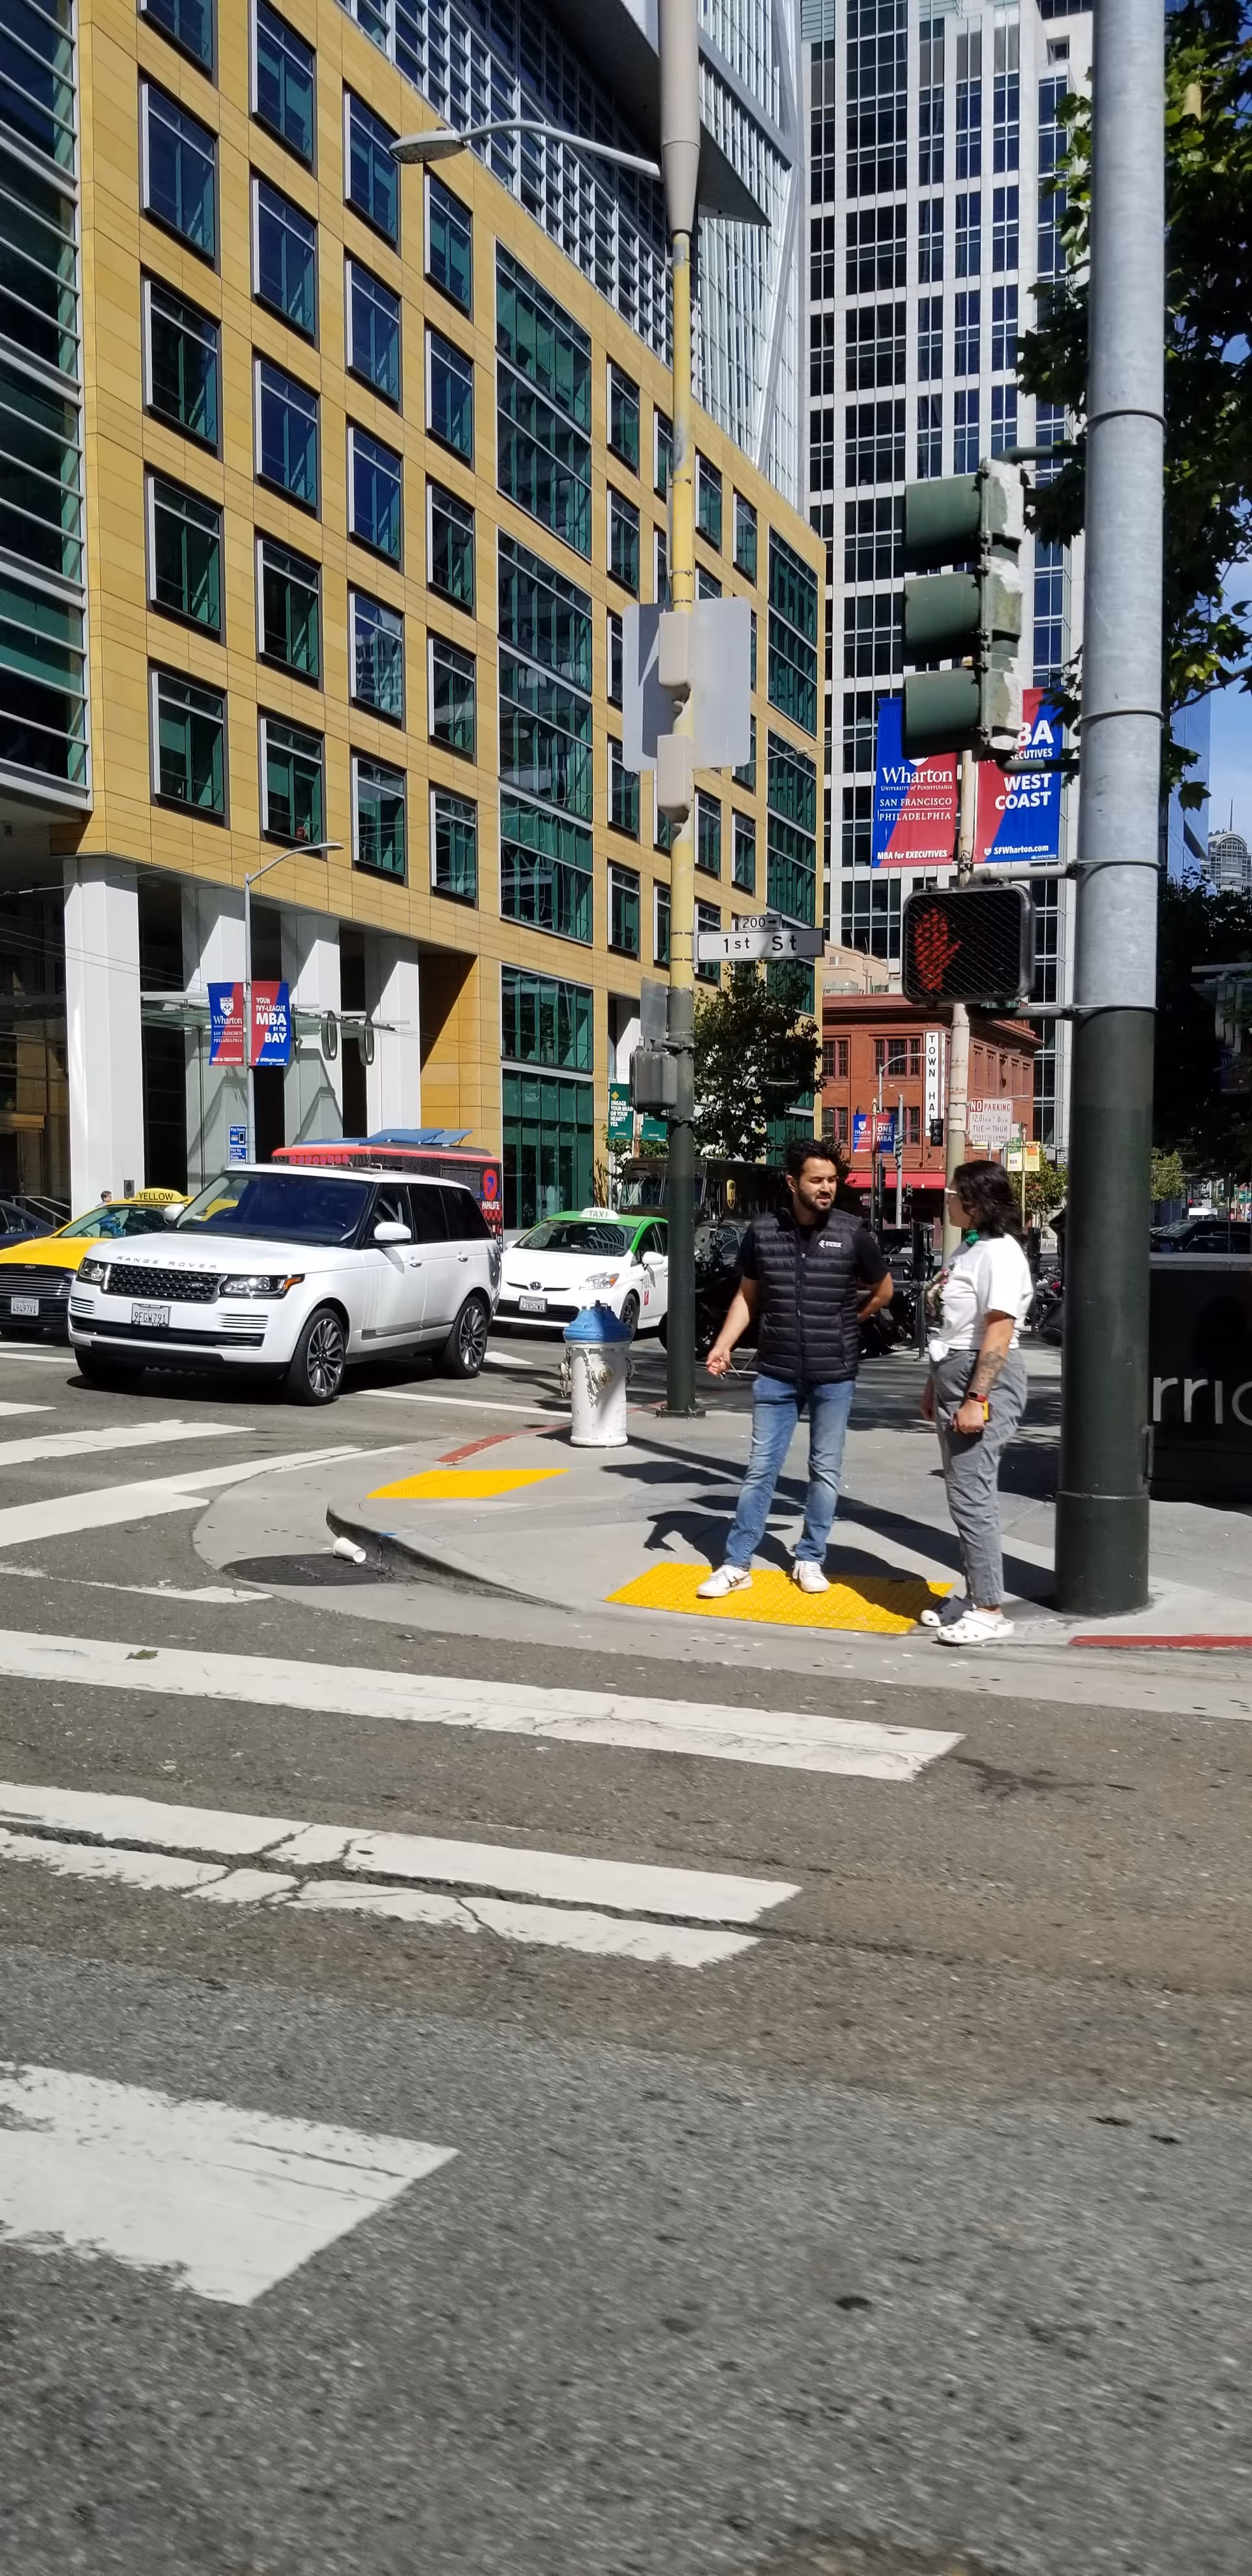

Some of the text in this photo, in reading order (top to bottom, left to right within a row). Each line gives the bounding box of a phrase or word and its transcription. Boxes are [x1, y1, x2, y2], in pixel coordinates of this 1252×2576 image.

[1017, 719, 1054, 747] BA
[882, 766, 953, 784] Wharton
[1004, 773, 1052, 791] WEST
[880, 798, 952, 807] SAN FRANCISCO
[995, 791, 1052, 810] COAST
[879, 812, 951, 822] PHILADELPHIA
[877, 850, 947, 860] MBA for EXECUTIVES
[994, 845, 1049, 855] SFWharton.com
[742, 917, 766, 928] 200
[724, 935, 797, 953] 1st St
[213, 1015, 243, 1025] Wharton
[256, 1013, 287, 1025] MBA
[265, 1032, 287, 1043] BAY
[928, 1035, 936, 1078] TOWN
[970, 1100, 1011, 1112] NO PARKING
[138, 1192, 173, 1201] YELLOW
[117, 1256, 217, 1269] RANGE ROVER
